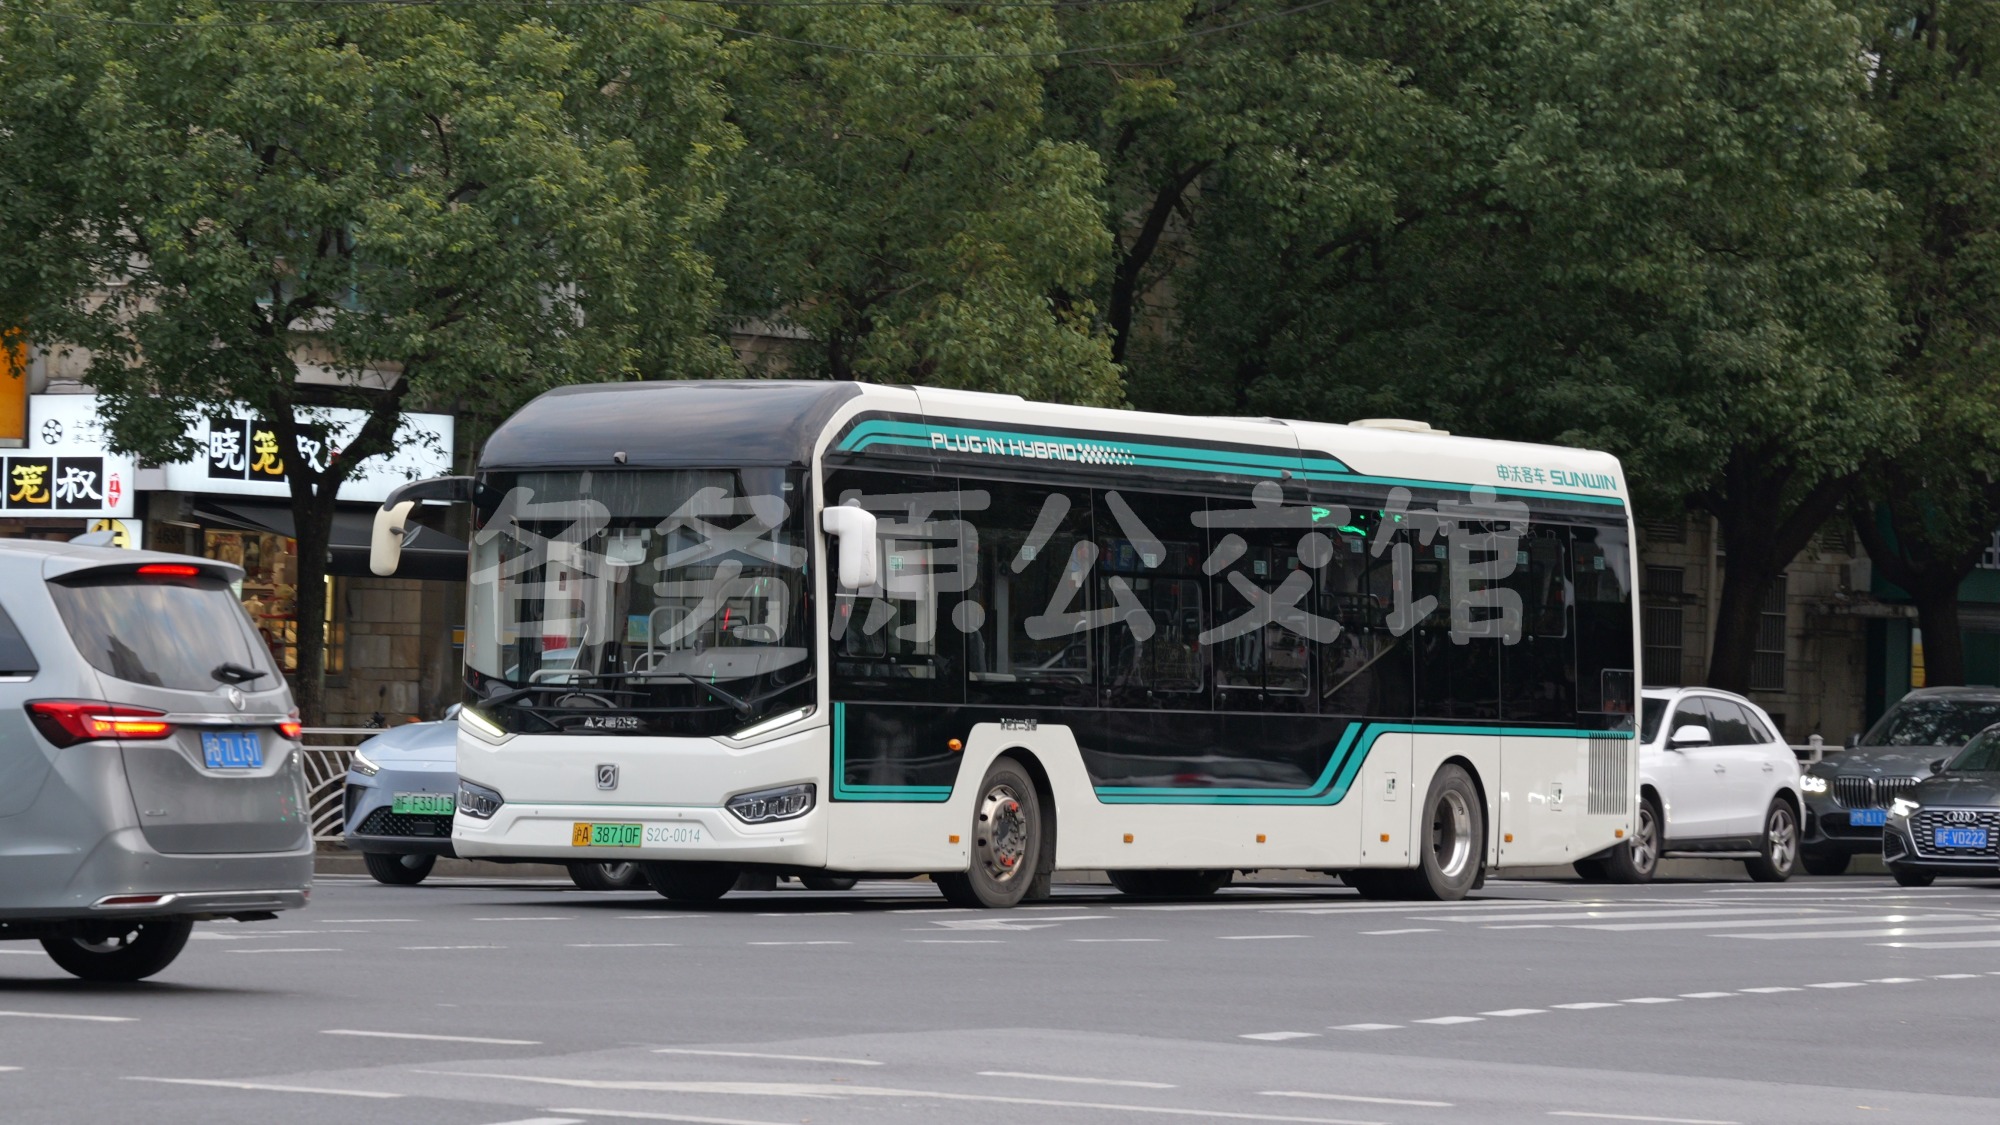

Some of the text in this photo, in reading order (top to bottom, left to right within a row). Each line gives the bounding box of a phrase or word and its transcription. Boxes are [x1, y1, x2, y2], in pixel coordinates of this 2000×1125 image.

[930, 432, 1078, 462] PLUG-IN HYBRID
[0, 465, 103, 504] 笼叔
[1496, 464, 1617, 491] 申沃客车 SUNWIN
[594, 826, 641, 844] 38710F
[646, 827, 701, 843] S2C-0014
